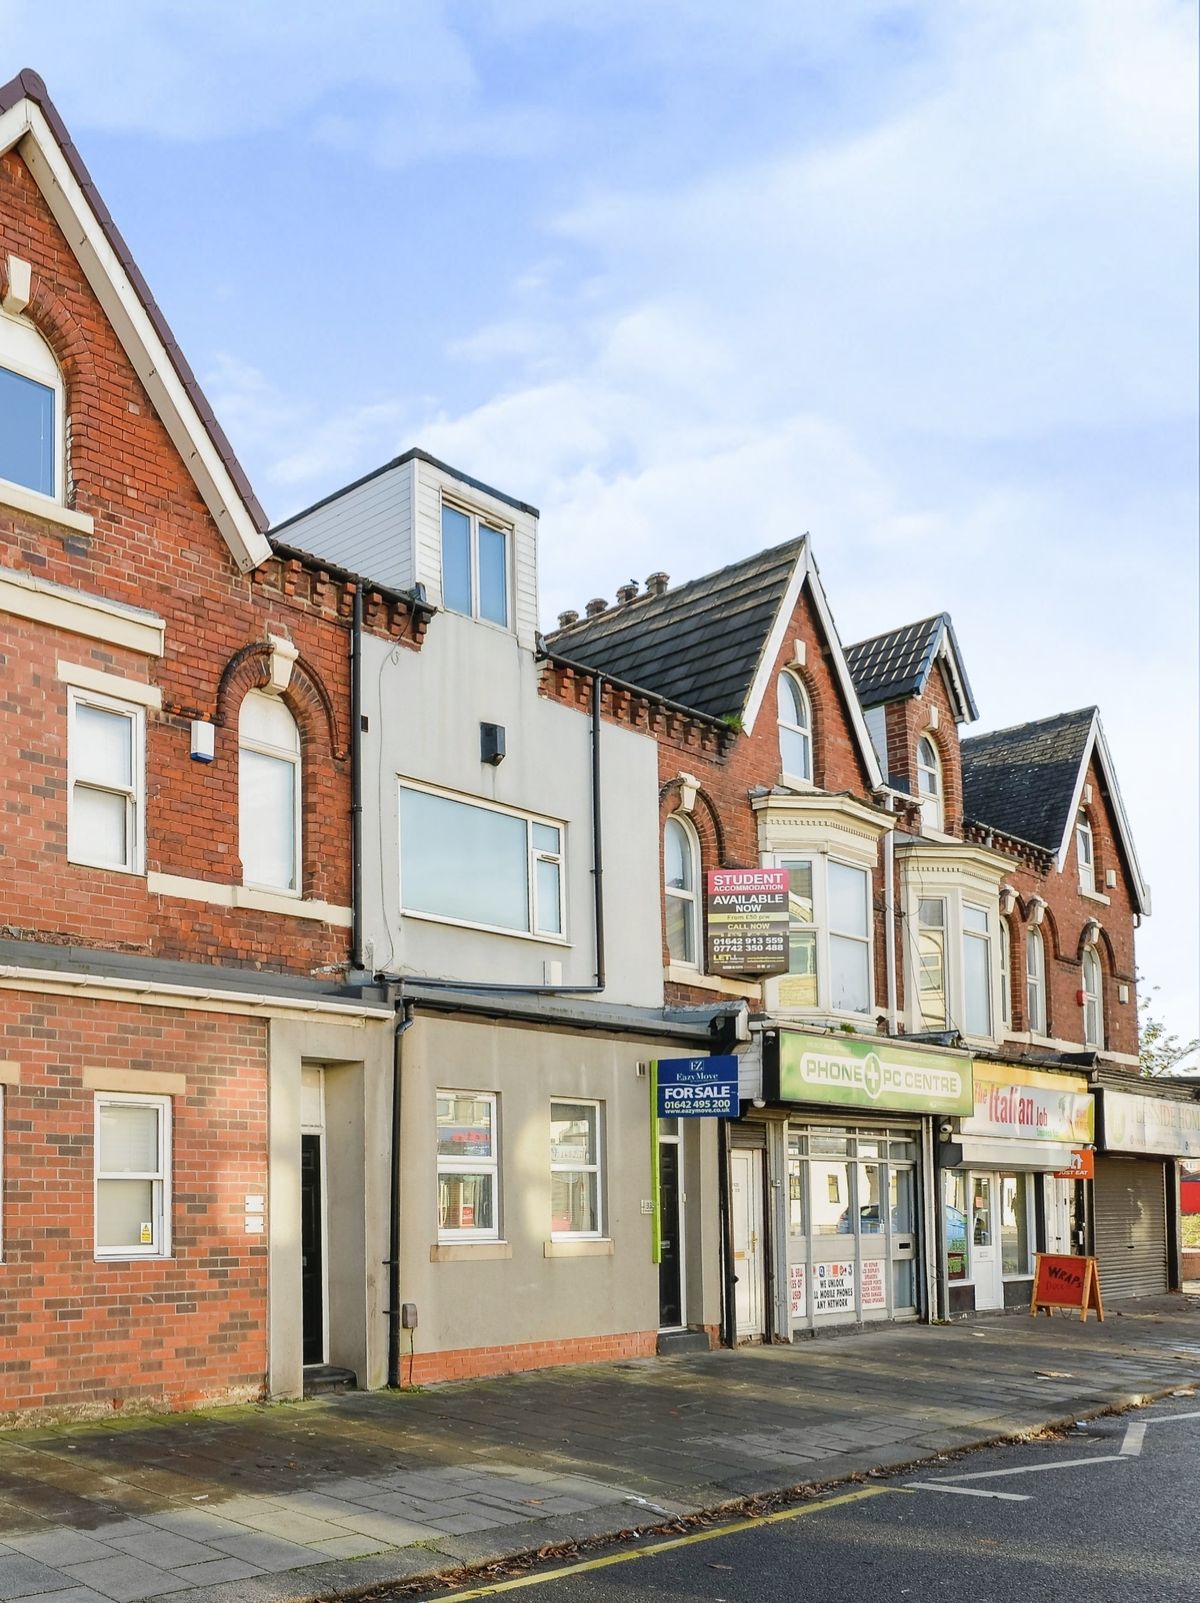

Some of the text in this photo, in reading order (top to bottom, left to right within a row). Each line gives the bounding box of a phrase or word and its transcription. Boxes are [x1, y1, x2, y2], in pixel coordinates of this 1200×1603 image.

[713, 873, 784, 885] STUDENT
[713, 884, 784, 892] ACCOMMODATION
[713, 894, 784, 905] AVAILABLE
[735, 904, 762, 912] NOW
[806, 1059, 957, 1093] PHONE PC CENTRE
[665, 1086, 730, 1099] FOR SALE
[664, 1099, 731, 1109] 01642 495 200
[974, 1082, 987, 1104] The
[990, 1085, 1033, 1126] Italian
[1036, 1106, 1048, 1127] Job
[820, 1279, 844, 1288] WE UNLOCK
[820, 1290, 835, 1299] MOBILE
[836, 1288, 853, 1298] PHONES
[817, 1299, 848, 1309] ANY NETWORK
